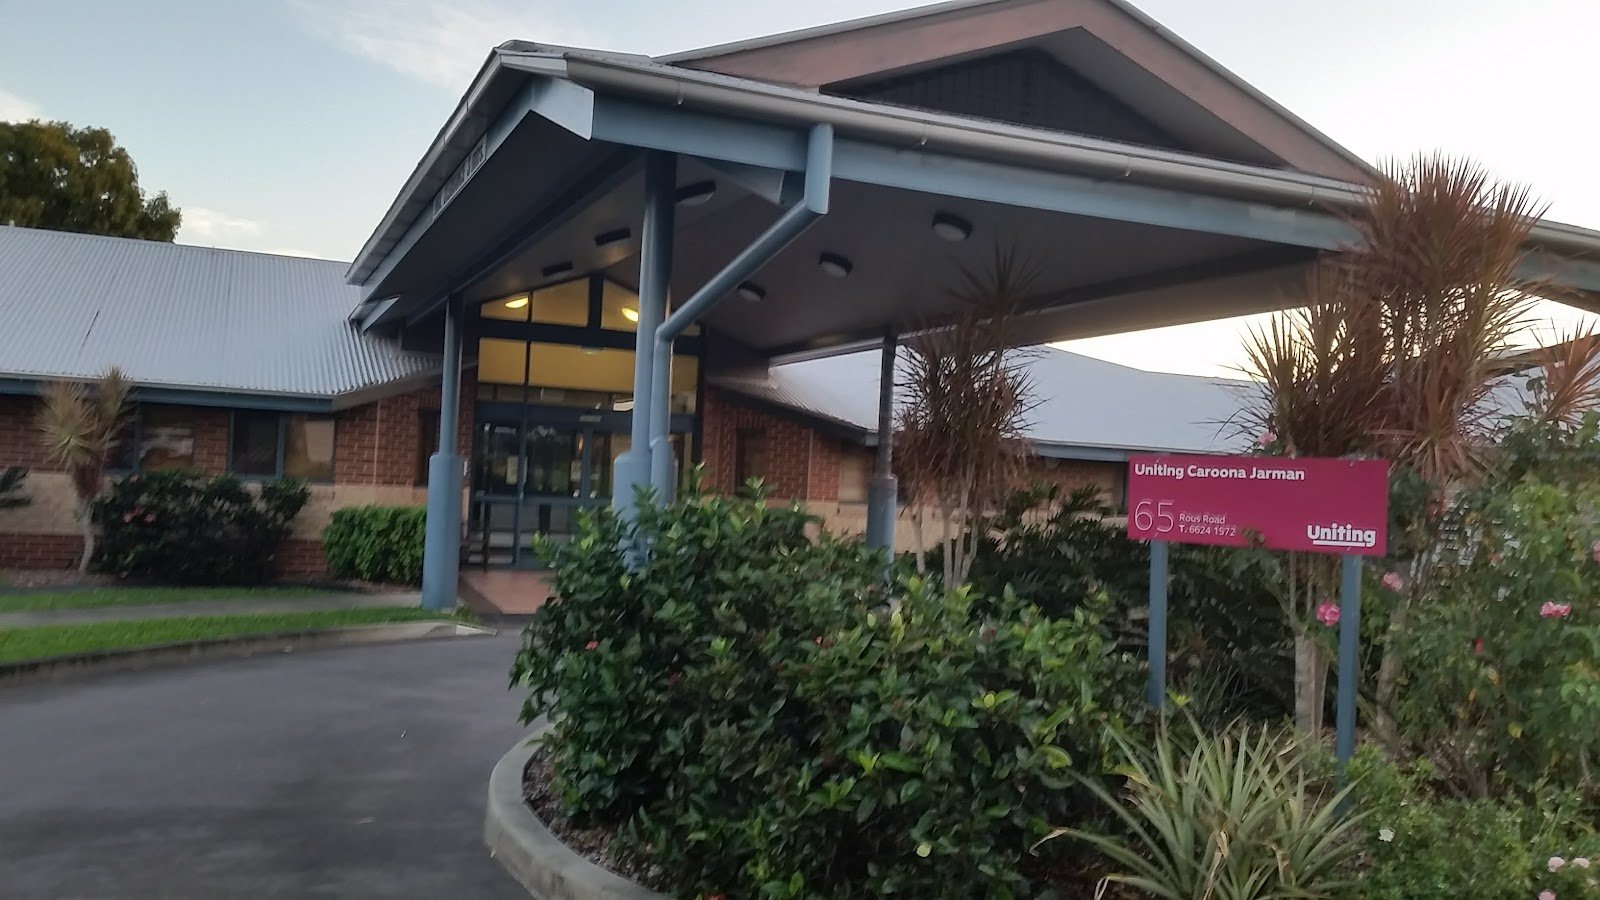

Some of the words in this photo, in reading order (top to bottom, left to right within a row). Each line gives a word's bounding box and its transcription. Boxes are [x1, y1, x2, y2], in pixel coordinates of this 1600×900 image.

[1134, 463, 1184, 480] Uniting
[1187, 465, 1247, 480] Caroona
[1250, 467, 1306, 481] Jarman
[1135, 501, 1174, 533] 65
[1179, 513, 1201, 523] Rous
[1203, 514, 1226, 525] Road
[1189, 525, 1211, 535] 6624
[1307, 522, 1377, 548] Uniting
